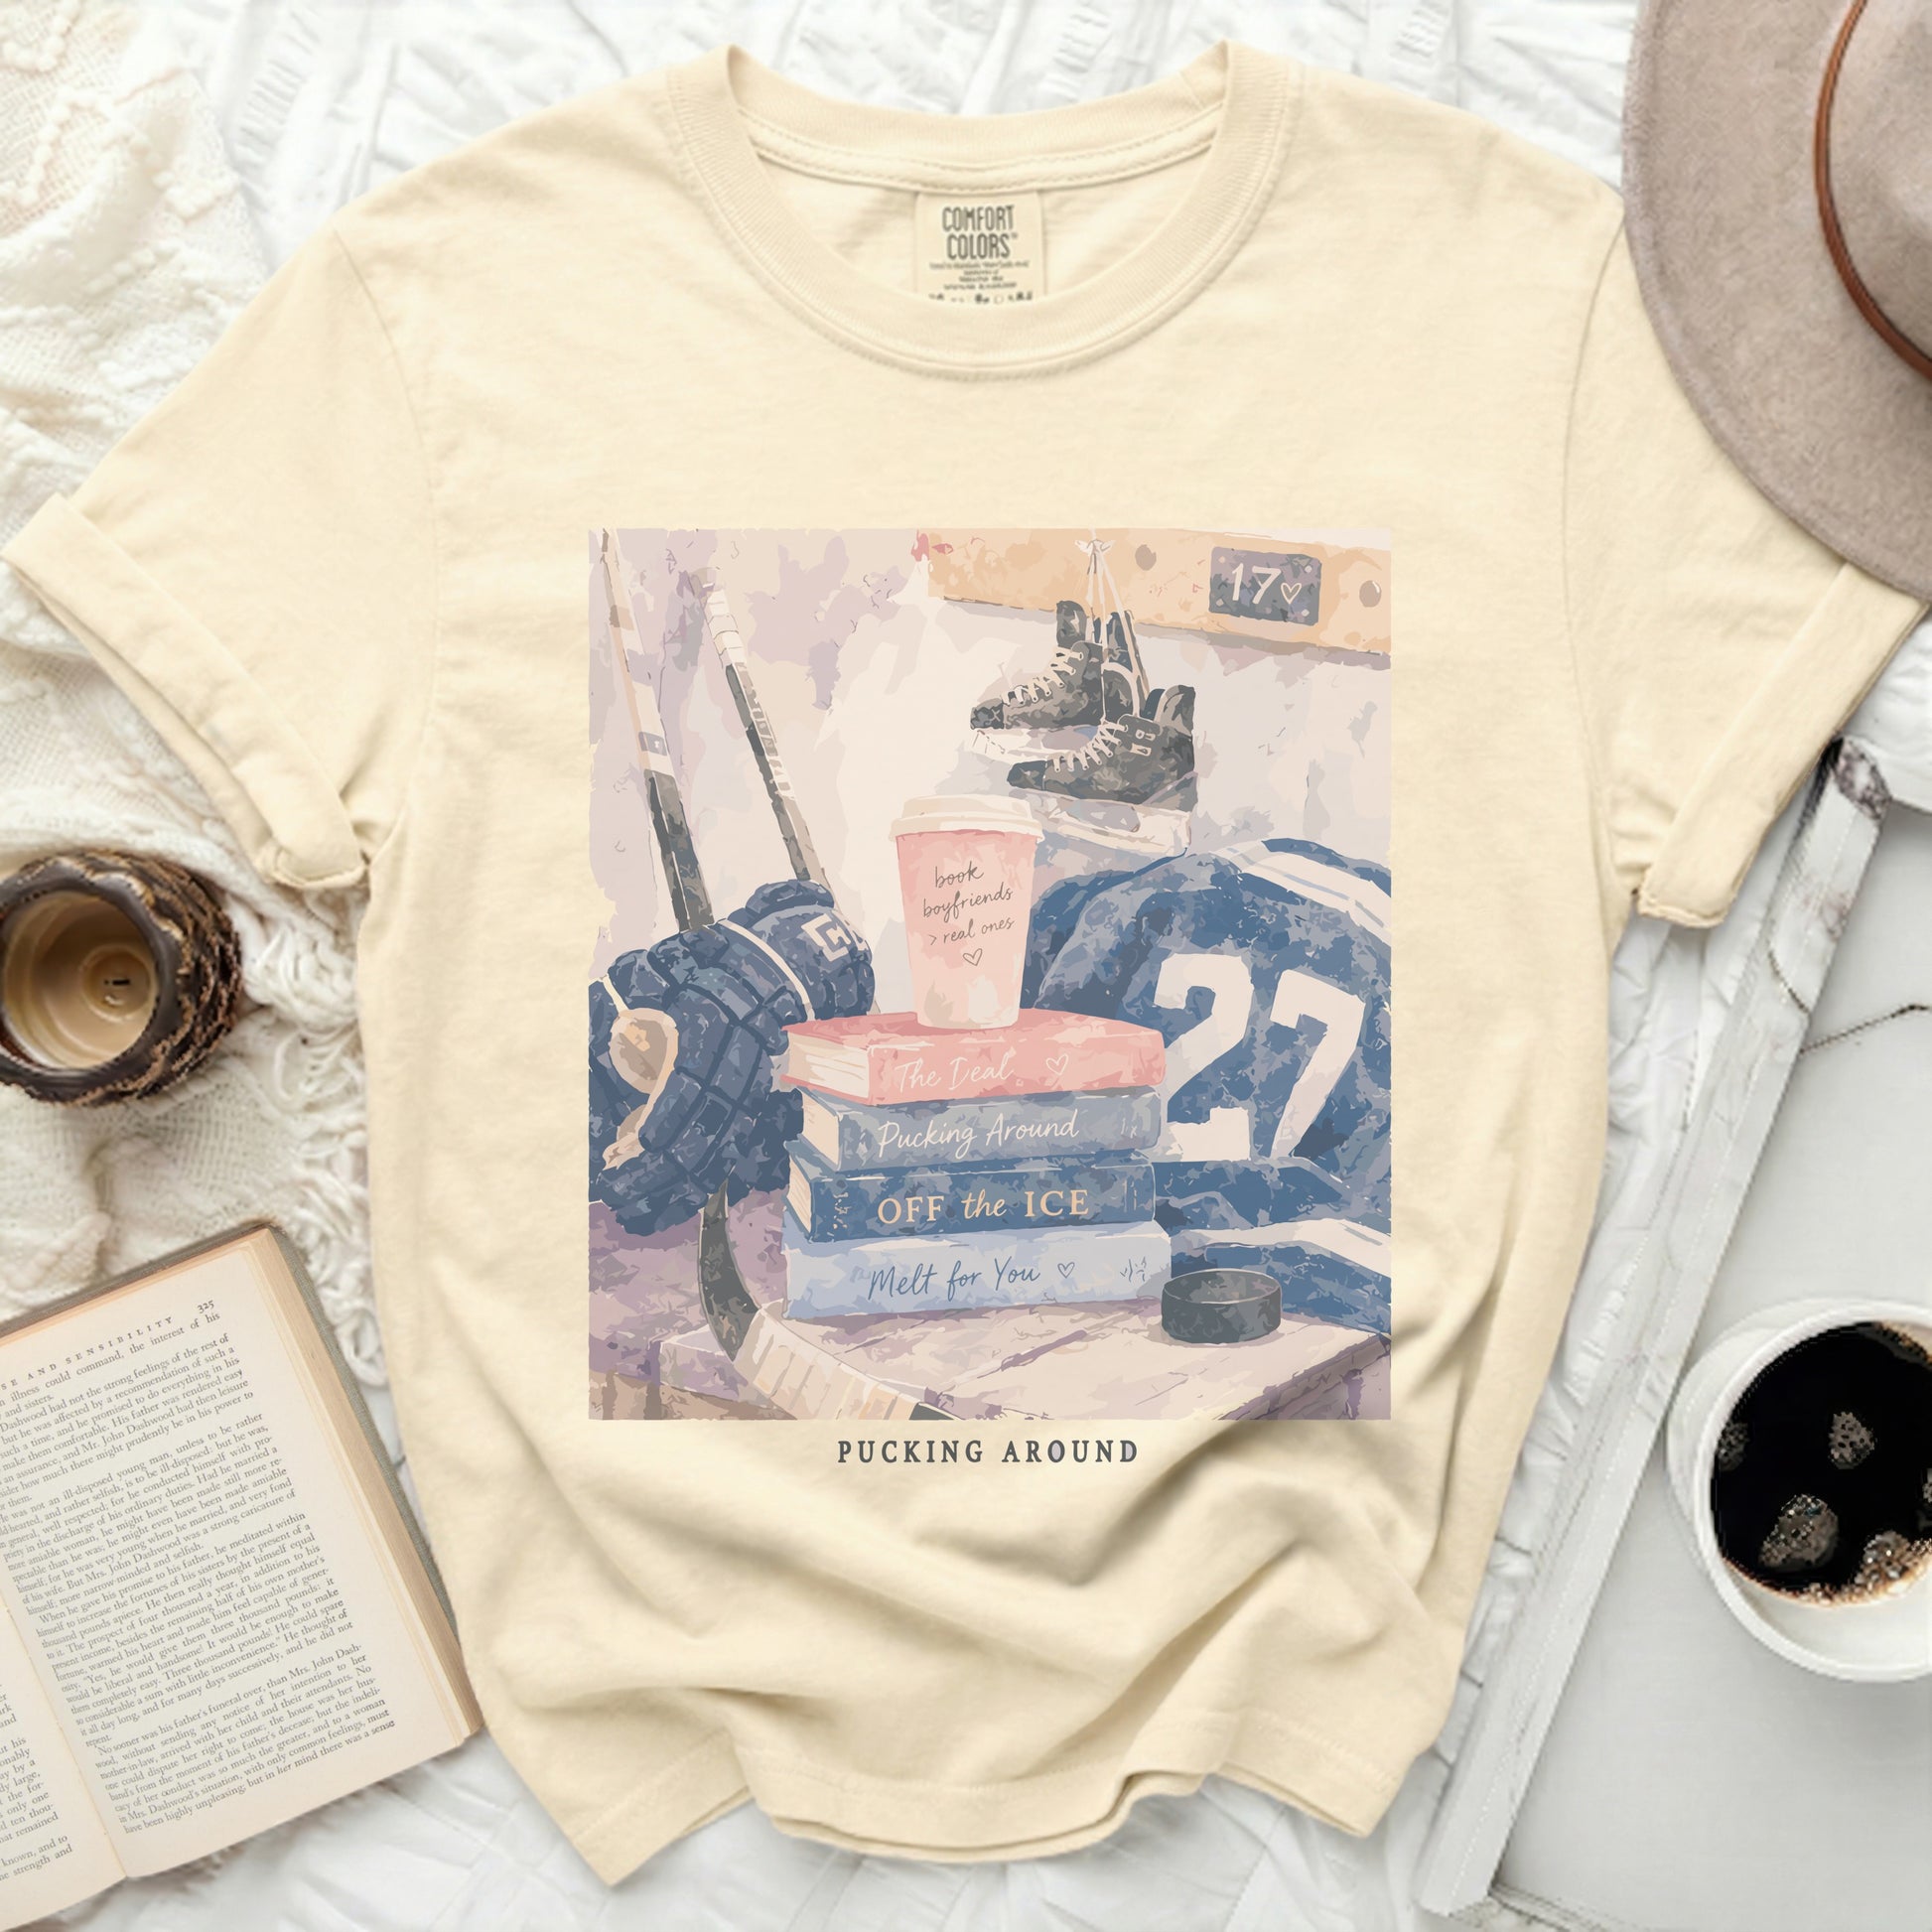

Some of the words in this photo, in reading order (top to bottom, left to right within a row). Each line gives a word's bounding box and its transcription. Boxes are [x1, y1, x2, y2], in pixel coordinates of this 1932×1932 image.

[941, 205, 1015, 231] COMFORT
[946, 232, 1012, 260] COLORS
[1231, 562, 1283, 606] 17
[934, 860, 985, 889] book
[922, 881, 1014, 924] boyfriends
[942, 918, 976, 944] real
[981, 916, 1015, 935] ones
[894, 1056, 942, 1093] The
[1153, 952, 1366, 1163] 27
[878, 1120, 977, 1160] Pucking
[985, 1108, 1080, 1148] Around
[878, 1195, 944, 1225] OFF
[961, 1188, 1008, 1220] the
[1025, 1188, 1089, 1218] ICE
[867, 1262, 938, 1301] Melt
[945, 1260, 982, 1303] for
[994, 1255, 1041, 1292] You
[10, 1386, 40, 1402] illness
[45, 1370, 70, 1388] could
[127, 1341, 146, 1355] the
[149, 1326, 185, 1345] interest
[189, 1316, 201, 1330] of
[203, 1311, 221, 1324] his
[27, 1362, 58, 1381] AND
[65, 1316, 171, 1364] SENSIBILITY
[196, 1299, 215, 1314] 325
[47, 1397, 69, 1414] had
[68, 1393, 85, 1406] not
[84, 1386, 103, 1399] the
[103, 1375, 134, 1391] strong
[133, 1359, 170, 1379] feelings
[170, 1351, 182, 1364] of
[182, 1347, 200, 1359] the
[201, 1339, 217, 1351] rest
[218, 1331, 229, 1345] of
[28, 1448, 52, 1460] them
[110, 1414, 130, 1428] His
[130, 1403, 159, 1419] father
[161, 1395, 181, 1407] was
[182, 1375, 221, 1398] rendered
[223, 1368, 242, 1381] easy
[61, 1445, 81, 1461] and
[101, 1431, 125, 1447] John
[125, 1407, 175, 1435] Dashwood
[174, 1398, 196, 1415] had
[196, 1394, 217, 1406] then
[216, 1377, 248, 1397] leisure
[10, 1508, 29, 1519] was
[29, 1501, 46, 1513] not
[47, 1496, 62, 1507] an
[63, 1472, 113, 1500] ill-disposed
[116, 1462, 147, 1481] young
[175, 1438, 205, 1453] unless
[206, 1430, 218, 1442] to
[217, 1425, 233, 1436] be
[235, 1413, 262, 1429] rather
[837, 1439, 984, 1464] PUCKING
[1001, 1439, 1139, 1464] AROUND
[65, 1578, 84, 1590] But
[108, 1558, 131, 1575] John
[132, 1536, 181, 1563] Dashwood
[182, 1530, 202, 1543] was
[209, 1515, 239, 1531] strong
[240, 1496, 284, 1518] caricature
[285, 1486, 296, 1500] of
[39, 1611, 67, 1623] When
[65, 1604, 79, 1616] he
[80, 1598, 100, 1612] gave
[118, 1577, 154, 1598] promise
[154, 1571, 166, 1581] to
[165, 1563, 182, 1577] his
[212, 1545, 227, 1556] he
[228, 1523, 274, 1549] meditated
[275, 1513, 306, 1529] within
[89, 1685, 104, 1697] be
[104, 1673, 133, 1691] liberal
[135, 1664, 155, 1680] and
[205, 1639, 217, 1650] It
[218, 1624, 248, 1643] would
[247, 1620, 263, 1632] be
[264, 1603, 299, 1624] enough
[300, 1599, 313, 1610] to
[314, 1587, 339, 1603] make
[112, 1737, 139, 1751] sooner
[140, 1729, 159, 1741] was
[157, 1723, 174, 1734] his
[173, 1709, 207, 1727] father's
[207, 1692, 241, 1714] funeral
[266, 1676, 287, 1688] than
[311, 1656, 334, 1671] John
[160, 1739, 191, 1759] arrived
[191, 1730, 214, 1745] with
[214, 1724, 233, 1736] her
[234, 1711, 258, 1727] child
[259, 1701, 279, 1718] and
[280, 1694, 302, 1708] their
[354, 1663, 372, 1677] No
[10, 1736, 27, 1748] his
[12, 1763, 25, 1774] by
[13, 1771, 41, 1786] large,
[123, 1824, 142, 1834] have
[142, 1817, 164, 1828] been
[164, 1805, 193, 1821] highly
[245, 1775, 264, 1788] but
[263, 1770, 276, 1781] in
[275, 1759, 292, 1775] her
[294, 1749, 318, 1767] mind
[320, 1741, 344, 1755] there
[344, 1732, 363, 1745] was
[370, 1720, 395, 1734] sense
[7, 1790, 24, 1802] the
[7, 1801, 27, 1815] only
[32, 1792, 50, 1804] one
[10, 1816, 26, 1827] ten
[15, 1811, 59, 1837] remained
[13, 1855, 51, 1875] strength
[55, 1843, 72, 1860] and
[38, 1838, 57, 1854] and
[58, 1835, 69, 1844] to
